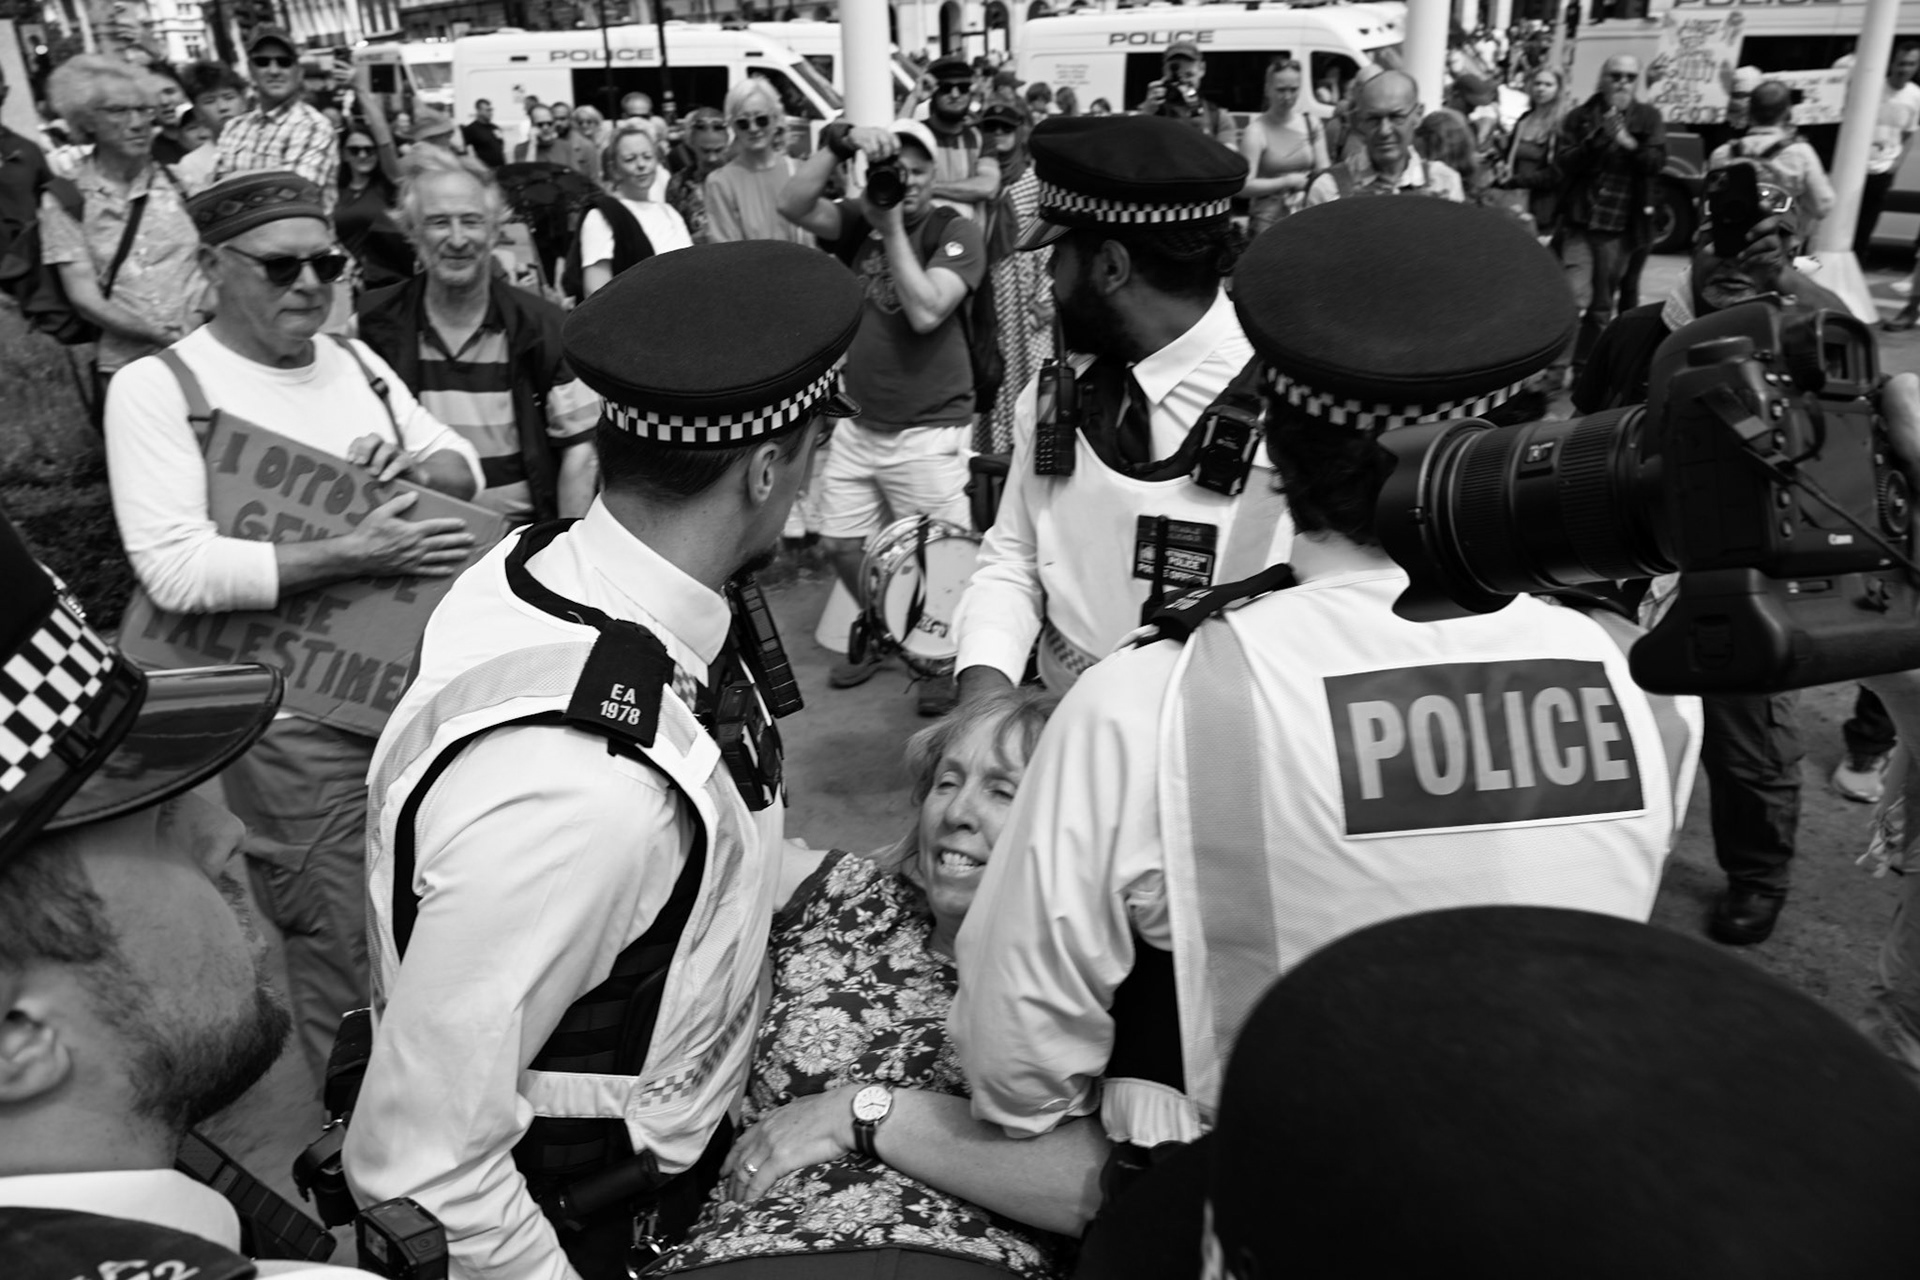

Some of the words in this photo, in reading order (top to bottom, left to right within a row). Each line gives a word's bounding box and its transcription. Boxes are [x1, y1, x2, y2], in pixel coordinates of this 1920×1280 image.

[1108, 30, 1215, 46] POLICE
[216, 432, 250, 475] I
[254, 445, 406, 526] OPPOS
[610, 683, 636, 704] EA
[600, 700, 641, 725] 1978
[1347, 687, 1630, 800] POLICE
